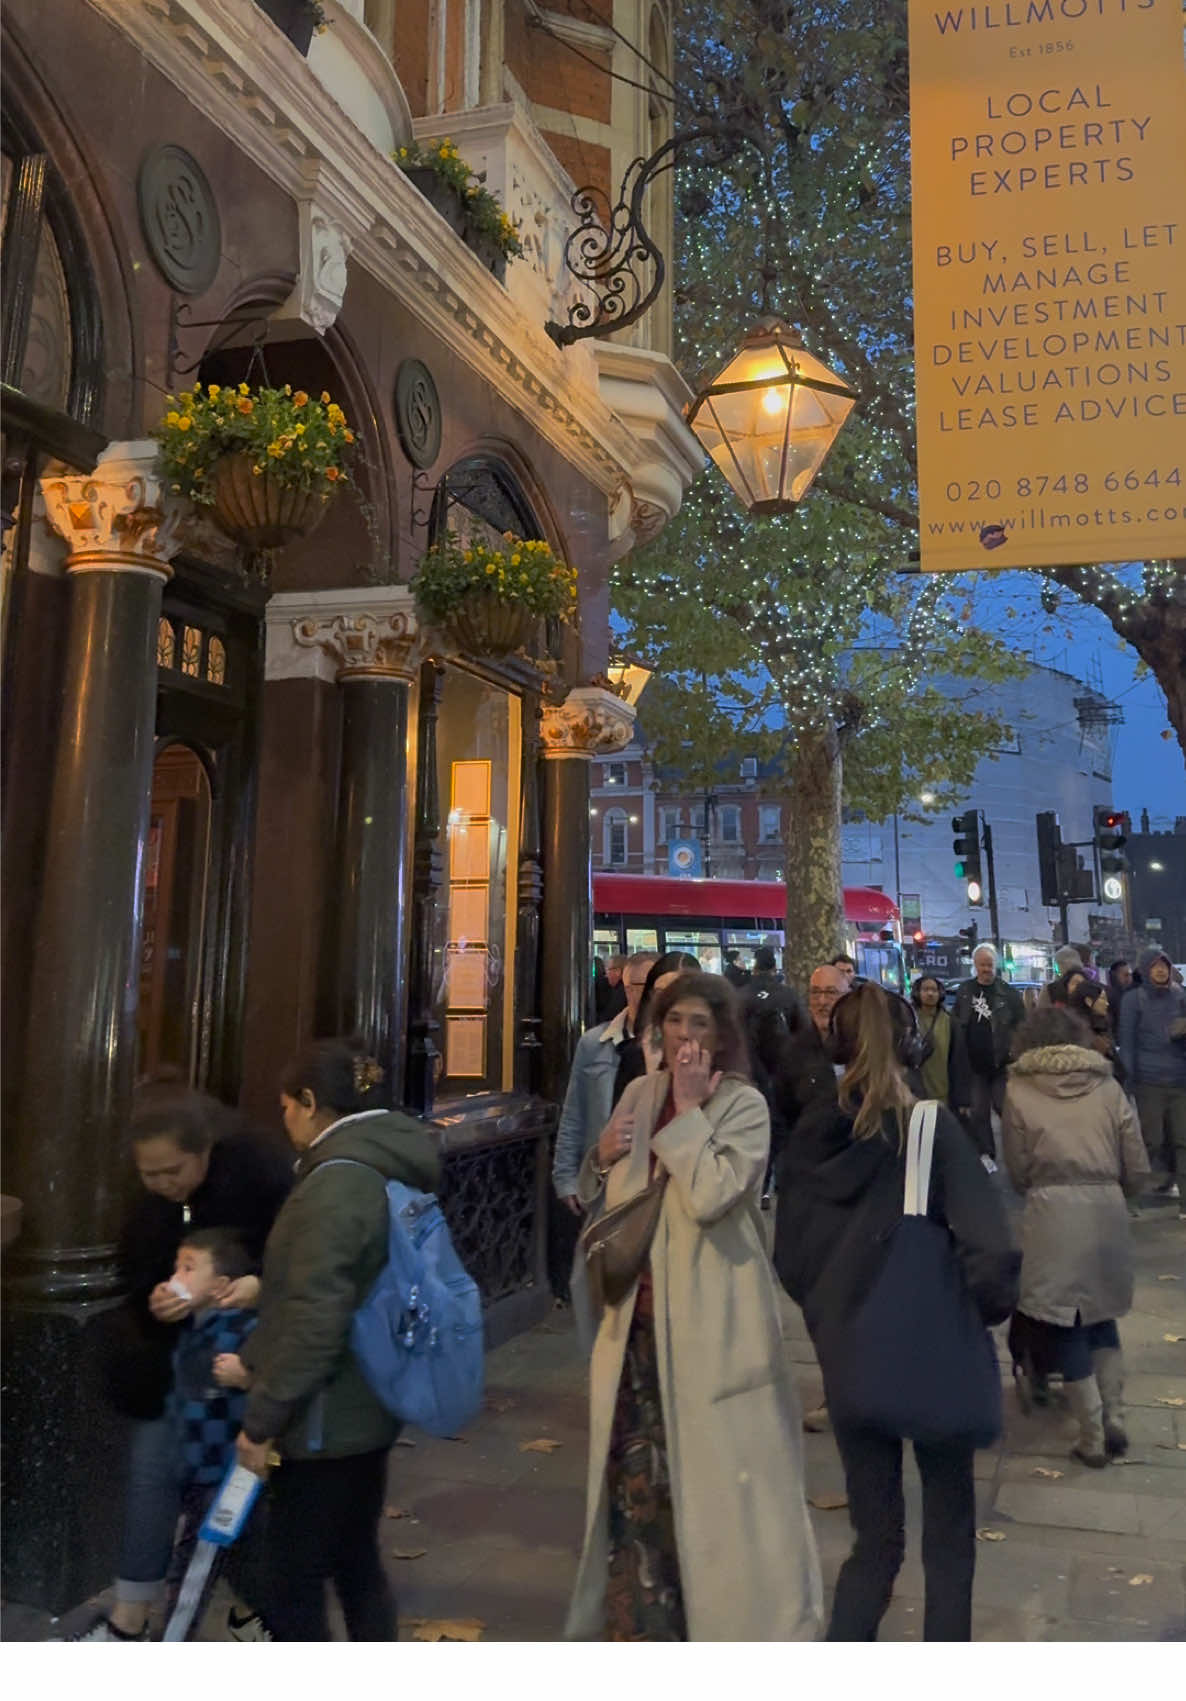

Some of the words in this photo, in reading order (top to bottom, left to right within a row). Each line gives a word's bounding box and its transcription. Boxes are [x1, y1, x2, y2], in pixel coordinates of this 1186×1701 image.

[1008, 46, 1032, 58] Est
[1039, 39, 1075, 55] 1856
[987, 84, 1112, 119] LOCAL
[951, 116, 1151, 161] PROPERTY
[970, 157, 1135, 196] EXPERTS
[936, 239, 1008, 267] BUY,
[1022, 231, 1108, 258] SELL,
[1123, 223, 1178, 249] LET
[982, 261, 1131, 294] MANAGE
[951, 291, 1168, 330] INVESTMENT
[932, 324, 1186, 366] DEVELOPMENT
[951, 360, 1171, 396] VALUATIONS
[939, 403, 1040, 432] LEASE
[1054, 393, 1186, 424] ADVICE
[946, 479, 1001, 501] 020
[1016, 473, 1089, 497] 8748
[1103, 467, 1182, 492] 6644
